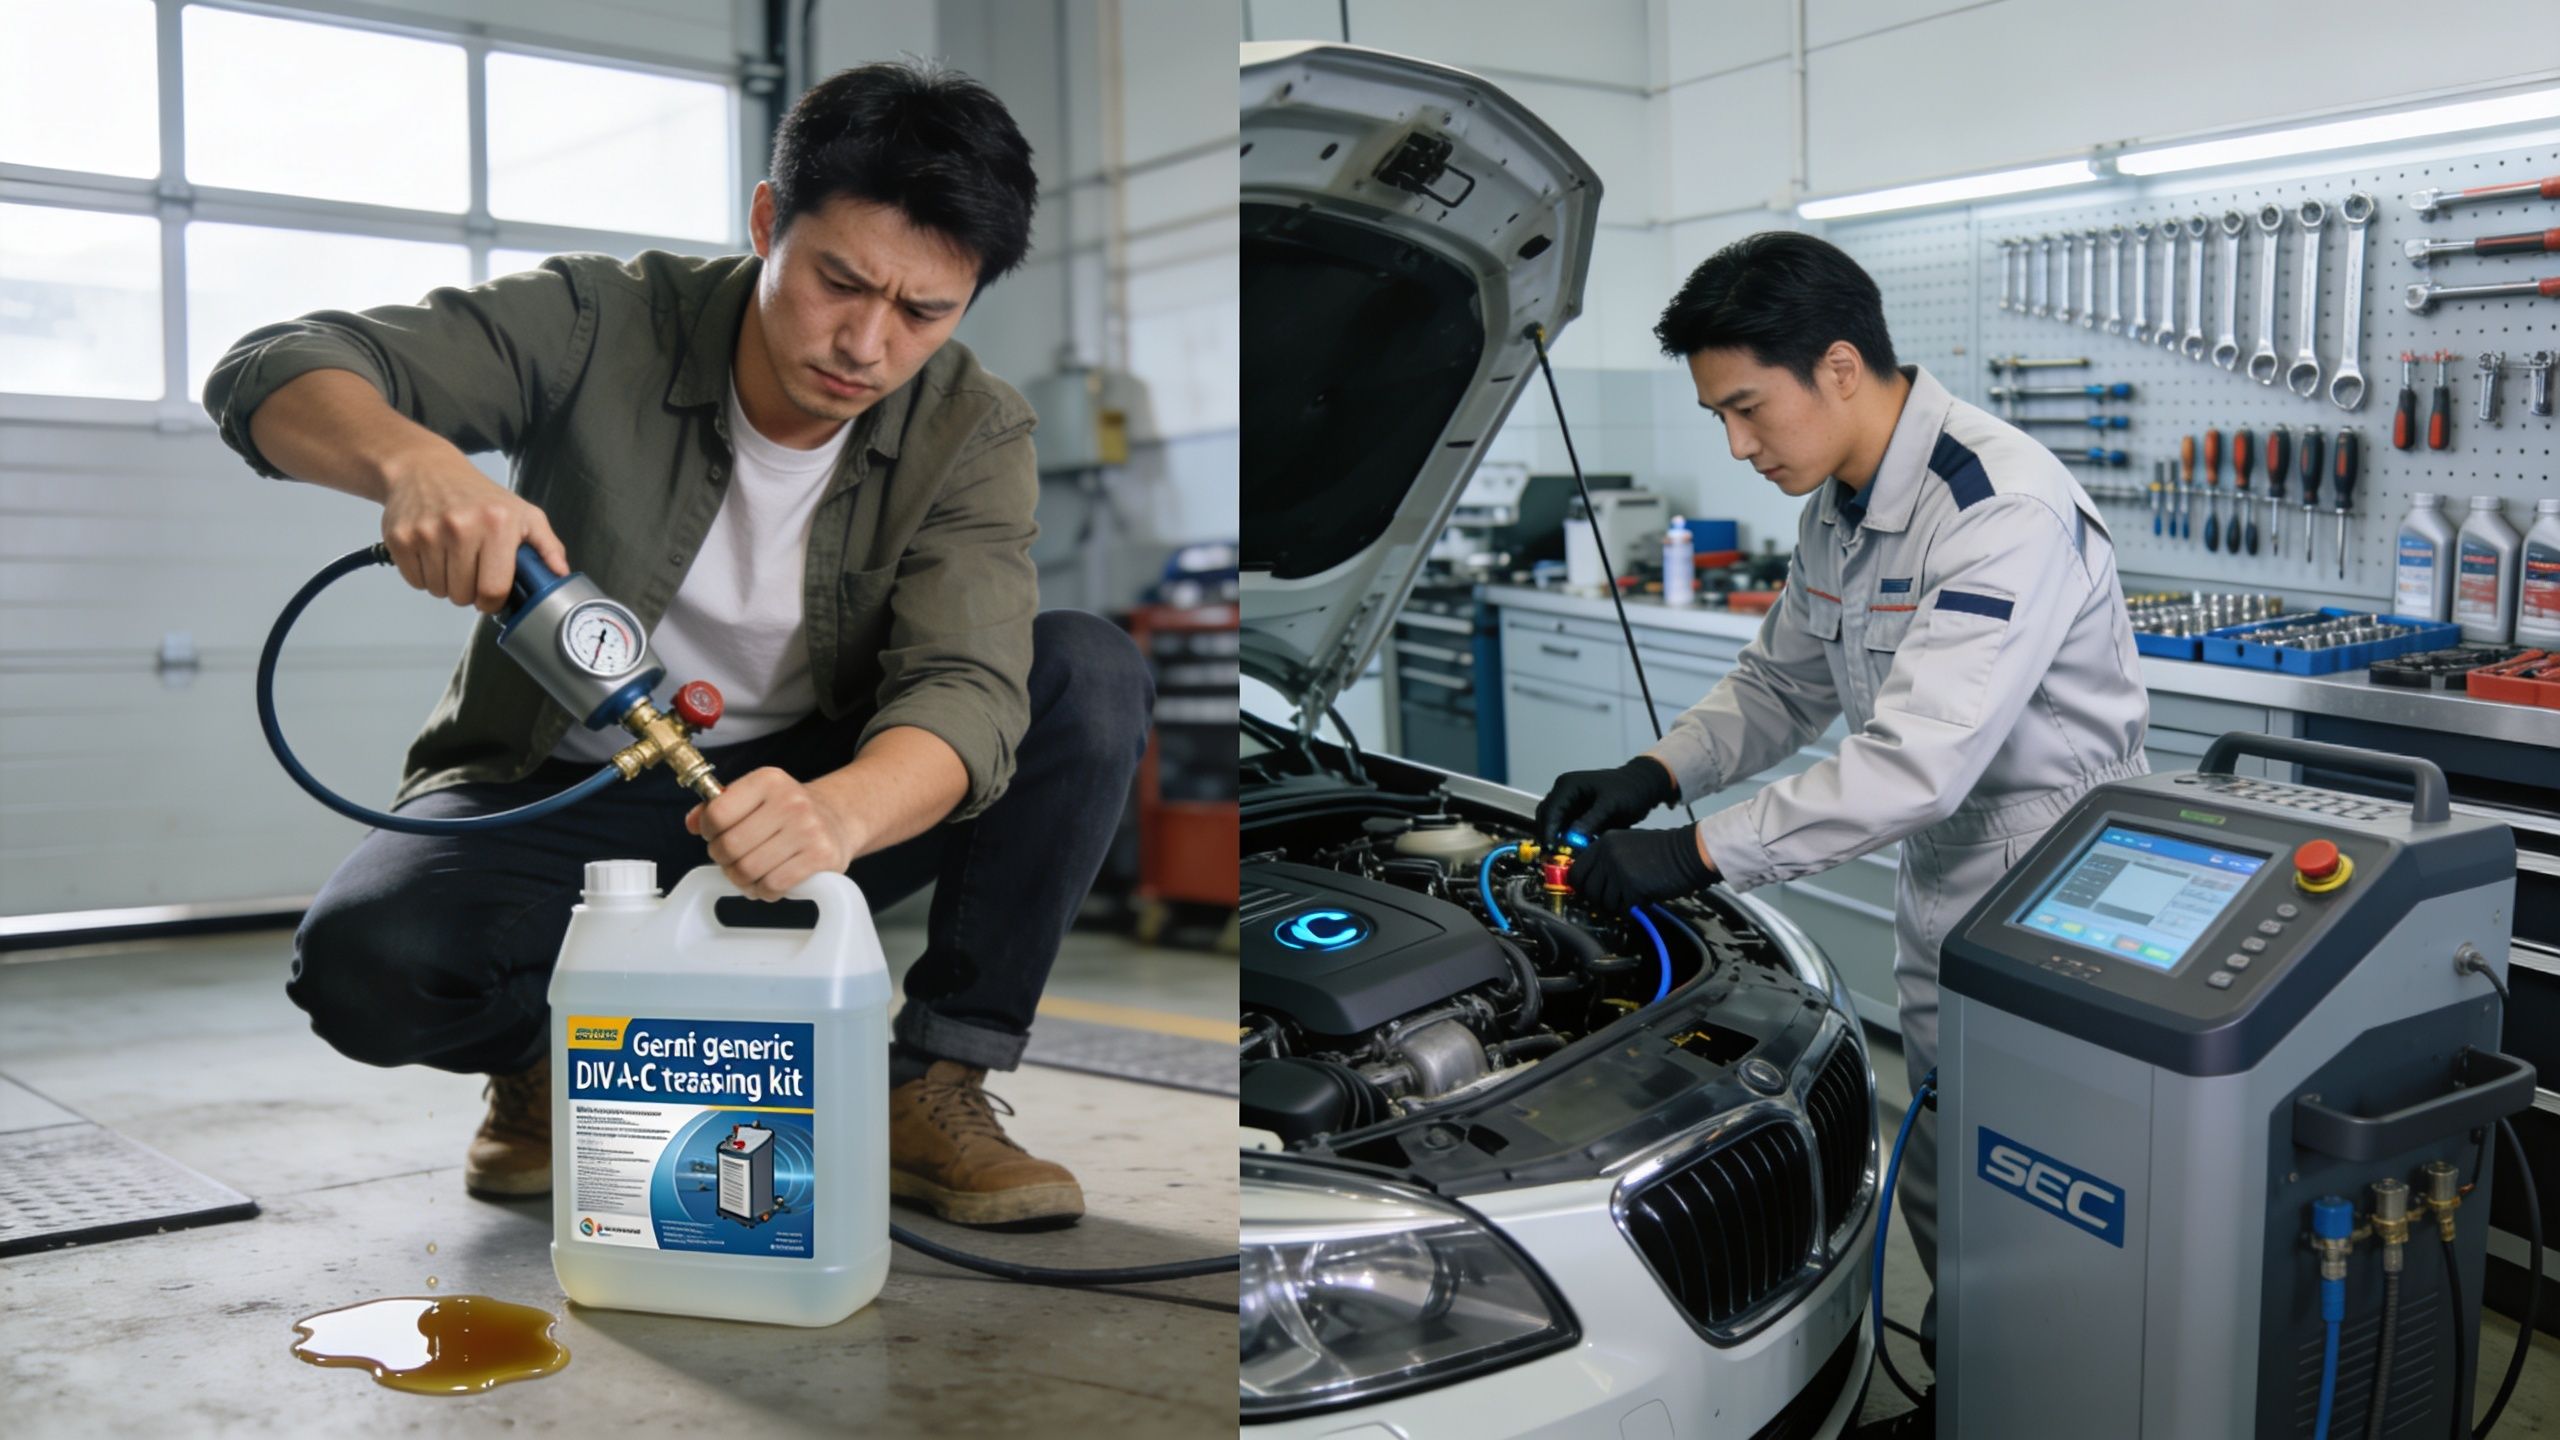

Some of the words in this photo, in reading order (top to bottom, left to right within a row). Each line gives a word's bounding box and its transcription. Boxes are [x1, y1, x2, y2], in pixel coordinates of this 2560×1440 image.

[702, 1033, 794, 1066] generic
[769, 1064, 804, 1097] kit
[1985, 1145, 2115, 1230] SEC
